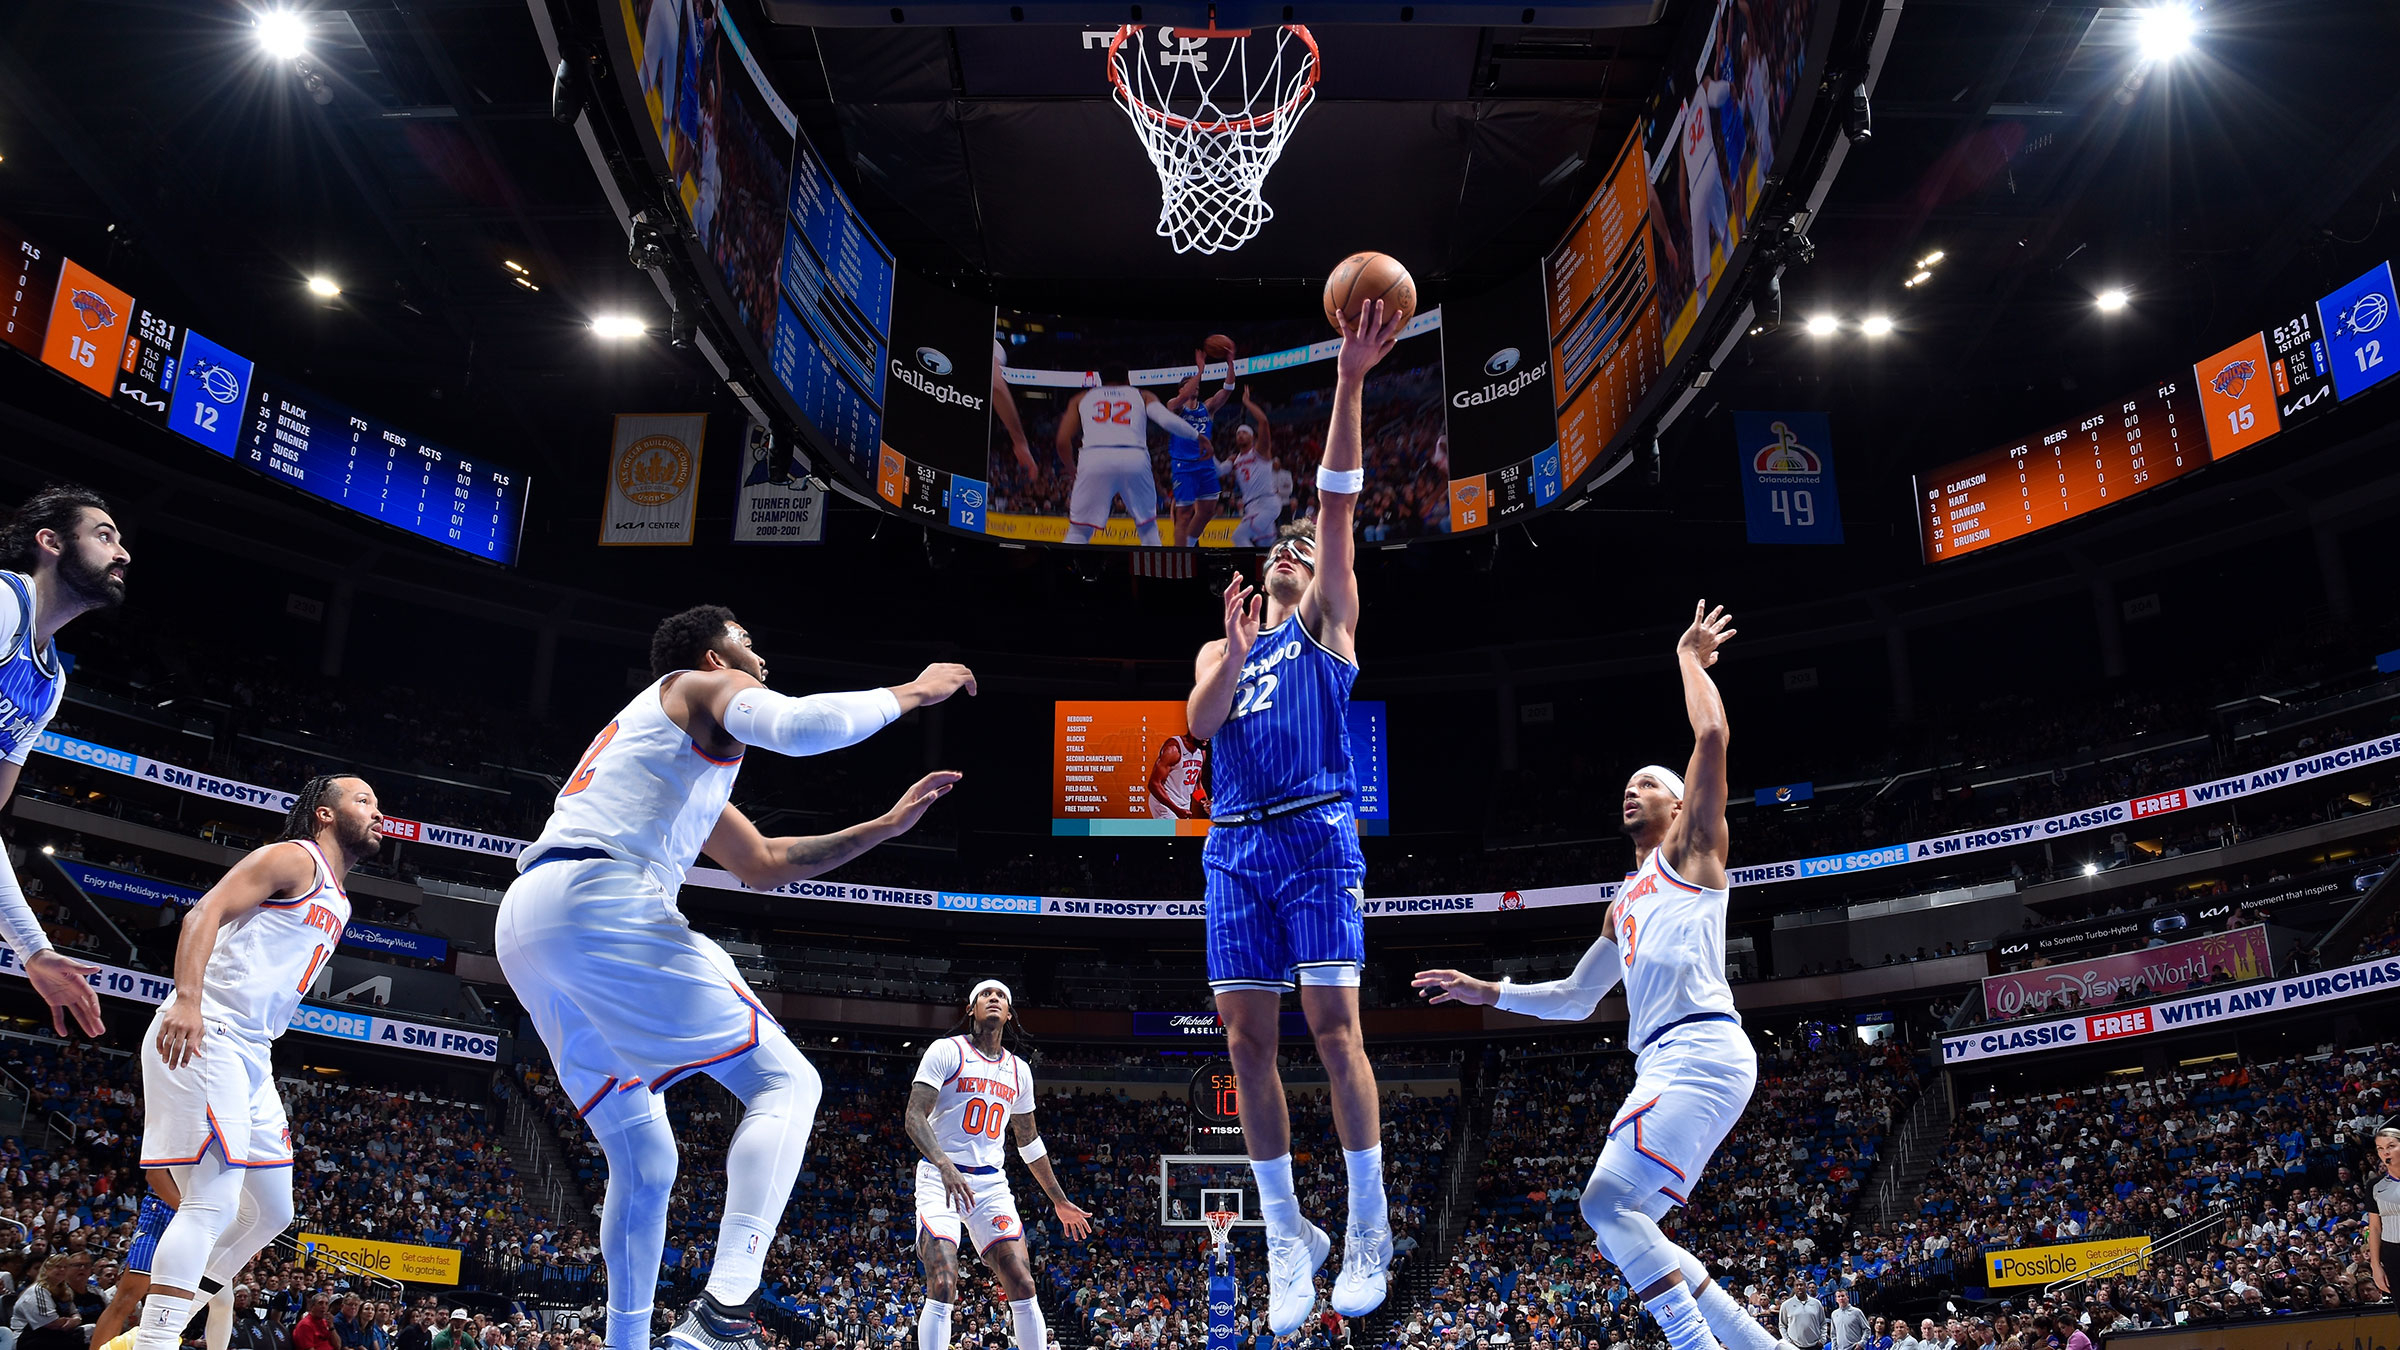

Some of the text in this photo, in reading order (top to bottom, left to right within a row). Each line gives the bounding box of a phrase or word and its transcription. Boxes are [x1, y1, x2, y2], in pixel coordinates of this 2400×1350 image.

[21, 241, 41, 260] FLS
[140, 309, 175, 341] 5:31
[2274, 314, 2310, 344] 5:31
[70, 335, 96, 368] 15
[140, 327, 172, 351] 1ST QTR
[2278, 331, 2311, 354] 1ST QTR
[143, 357, 157, 372] TOL
[144, 348, 160, 362] FLS
[2290, 351, 2306, 364] FLS
[2354, 340, 2384, 372] 12
[140, 368, 156, 382] CHL
[2292, 363, 2308, 375] TOL
[2294, 372, 2310, 386] CHL
[891, 359, 984, 411] Gallagher
[1452, 360, 1546, 408] Gallagher
[194, 401, 218, 432] 12
[262, 392, 306, 420] 0 BLACK
[1092, 401, 1132, 426] 32
[259, 406, 311, 436] 35 BITADZE
[2010, 384, 2176, 458] PTS REBS ASTS FG FLS
[2228, 404, 2254, 435] 15
[256, 420, 308, 450] 22 WAGNER
[254, 435, 299, 462] 4 SUGGS
[350, 416, 510, 486] PTS REBS ASTS FG FLS
[624, 439, 689, 484] GREEN BUILDING COUNCIL
[250, 450, 304, 480] 23 DA SILVA
[918, 466, 935, 480] 5:31
[1501, 466, 1520, 480] 5:31
[884, 480, 894, 497] 15
[1544, 481, 1556, 498] 12
[1929, 473, 1986, 500] 00 CLARKSON
[752, 498, 812, 510] TURNER CUP
[1771, 490, 1814, 526] 49
[1930, 493, 1968, 513] 3 HART
[1932, 502, 1986, 527] 51 DIAWARA
[648, 522, 680, 530] CENTER
[751, 510, 808, 523] CHAMPIONS
[961, 510, 974, 526] 12
[1462, 510, 1476, 525] 15
[1934, 518, 1980, 540] 32 TOWNS
[756, 526, 800, 536] 2000-2001
[1936, 528, 1990, 553] 11 BRUNSON
[1230, 674, 1279, 720] 22
[33, 733, 60, 751] OU
[62, 740, 132, 772] SCORE
[145, 764, 159, 778] A
[164, 768, 193, 788] SM
[382, 818, 516, 854] REE WITH ANY
[1732, 864, 1795, 884] THREES
[1805, 858, 1842, 874] YOU
[1846, 848, 1904, 868] SCORE
[1917, 844, 1928, 858] A
[1934, 838, 1961, 854] SM
[2044, 806, 2124, 834] CLASSIC
[2137, 792, 2180, 814] FREE
[2192, 779, 2246, 802] WITH
[2251, 767, 2290, 790] ANY
[84, 874, 108, 888] Enjoy
[108, 878, 122, 890] the
[124, 882, 160, 900] Holidays
[789, 882, 846, 898] SCORE
[850, 888, 868, 900] 10
[872, 890, 932, 906] THREES
[943, 896, 978, 910] YOU
[980, 897, 1037, 912] SCORE
[1050, 901, 1061, 912] A
[1064, 902, 1090, 914] SM
[1166, 904, 1206, 916] CLAS
[1600, 886, 1614, 898] IF
[2241, 882, 2338, 910] Movement that inspires
[1386, 898, 1474, 912] PURCHASE
[304, 904, 334, 937] NEW
[1622, 914, 1636, 969] 3
[2040, 924, 2138, 948] Kia Sorento Turbo-Hybrid
[2142, 956, 2208, 989] World
[291, 1008, 497, 1057] SCORE A SM FROS
[1170, 1015, 1214, 1026] Michelob
[1980, 1024, 2076, 1054] CLASSIC
[2093, 1012, 2146, 1038] FREE
[2160, 998, 2222, 1025] WITH
[2228, 987, 2278, 1014] ANY
[956, 1077, 1016, 1104] NEW YORK
[1216, 1090, 1238, 1116] 10
[962, 1097, 1004, 1140] 00
[318, 1244, 450, 1270] Possible Get cash fast.
[2004, 1248, 2122, 1278] Possible Get cash
[402, 1264, 446, 1277] No gotchas.
